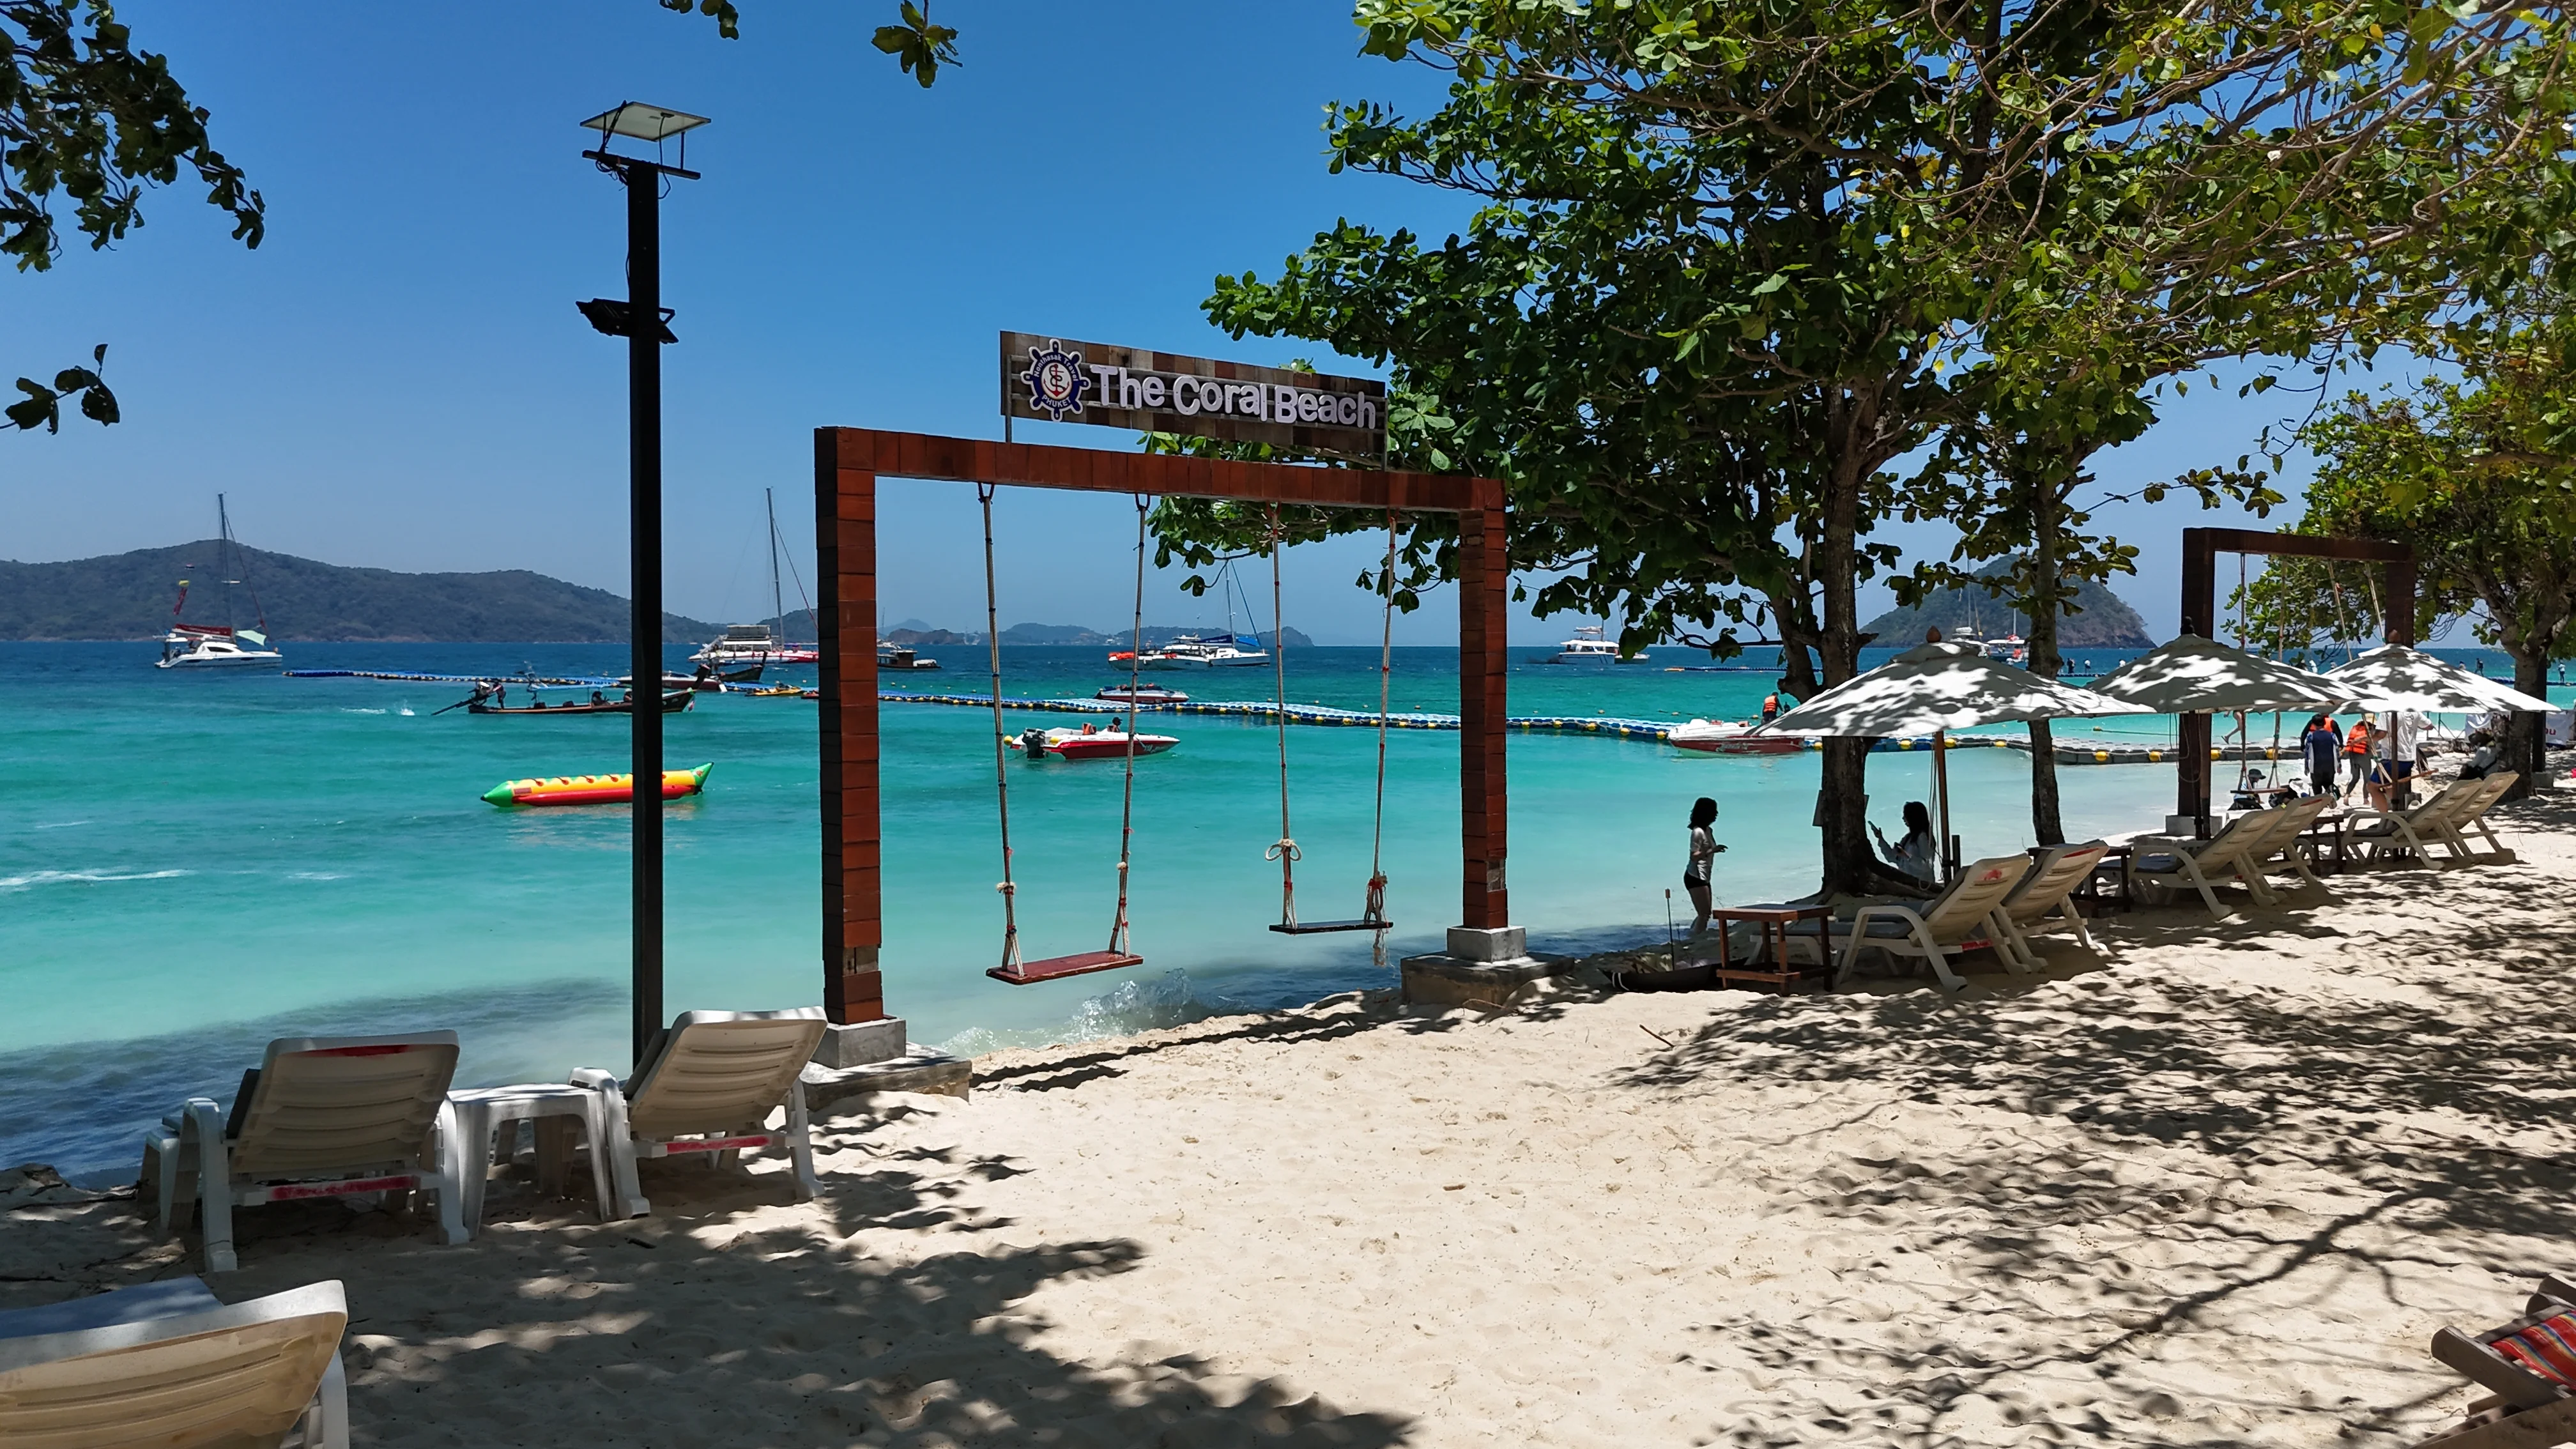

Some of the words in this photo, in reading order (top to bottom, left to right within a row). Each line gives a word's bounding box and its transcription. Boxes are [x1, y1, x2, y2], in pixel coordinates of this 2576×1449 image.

[1034, 354, 1062, 378] Nonthasak
[1064, 357, 1079, 381] Travel
[1041, 394, 1071, 408] PHUKET
[1090, 365, 1165, 409] The
[1172, 375, 1268, 422] Coral
[1275, 385, 1376, 430] Beach
